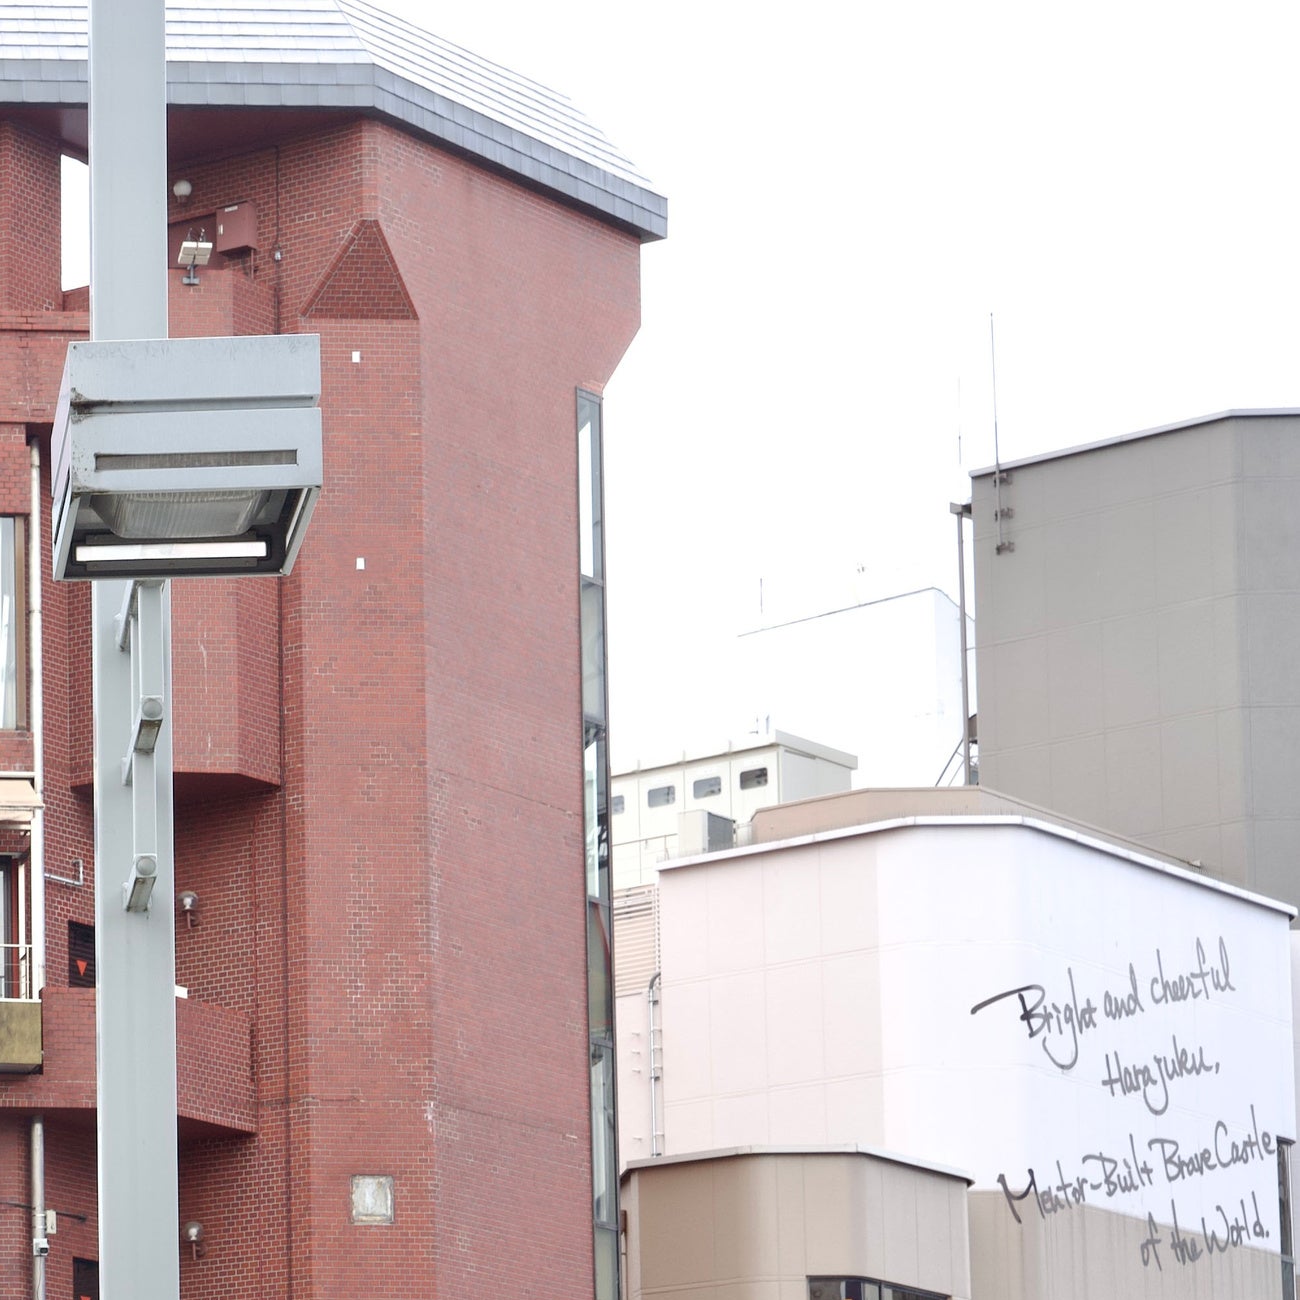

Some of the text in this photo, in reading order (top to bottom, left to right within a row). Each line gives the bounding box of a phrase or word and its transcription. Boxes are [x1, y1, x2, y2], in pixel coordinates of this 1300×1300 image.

[970, 936, 1236, 1071] Bright and cheerful
[1102, 1034, 1220, 1115] Harajuku,
[1147, 1137, 1218, 1183] Brave
[1213, 1103, 1276, 1169] Castle
[1140, 1211, 1163, 1272] of
[1170, 1198, 1204, 1266] the
